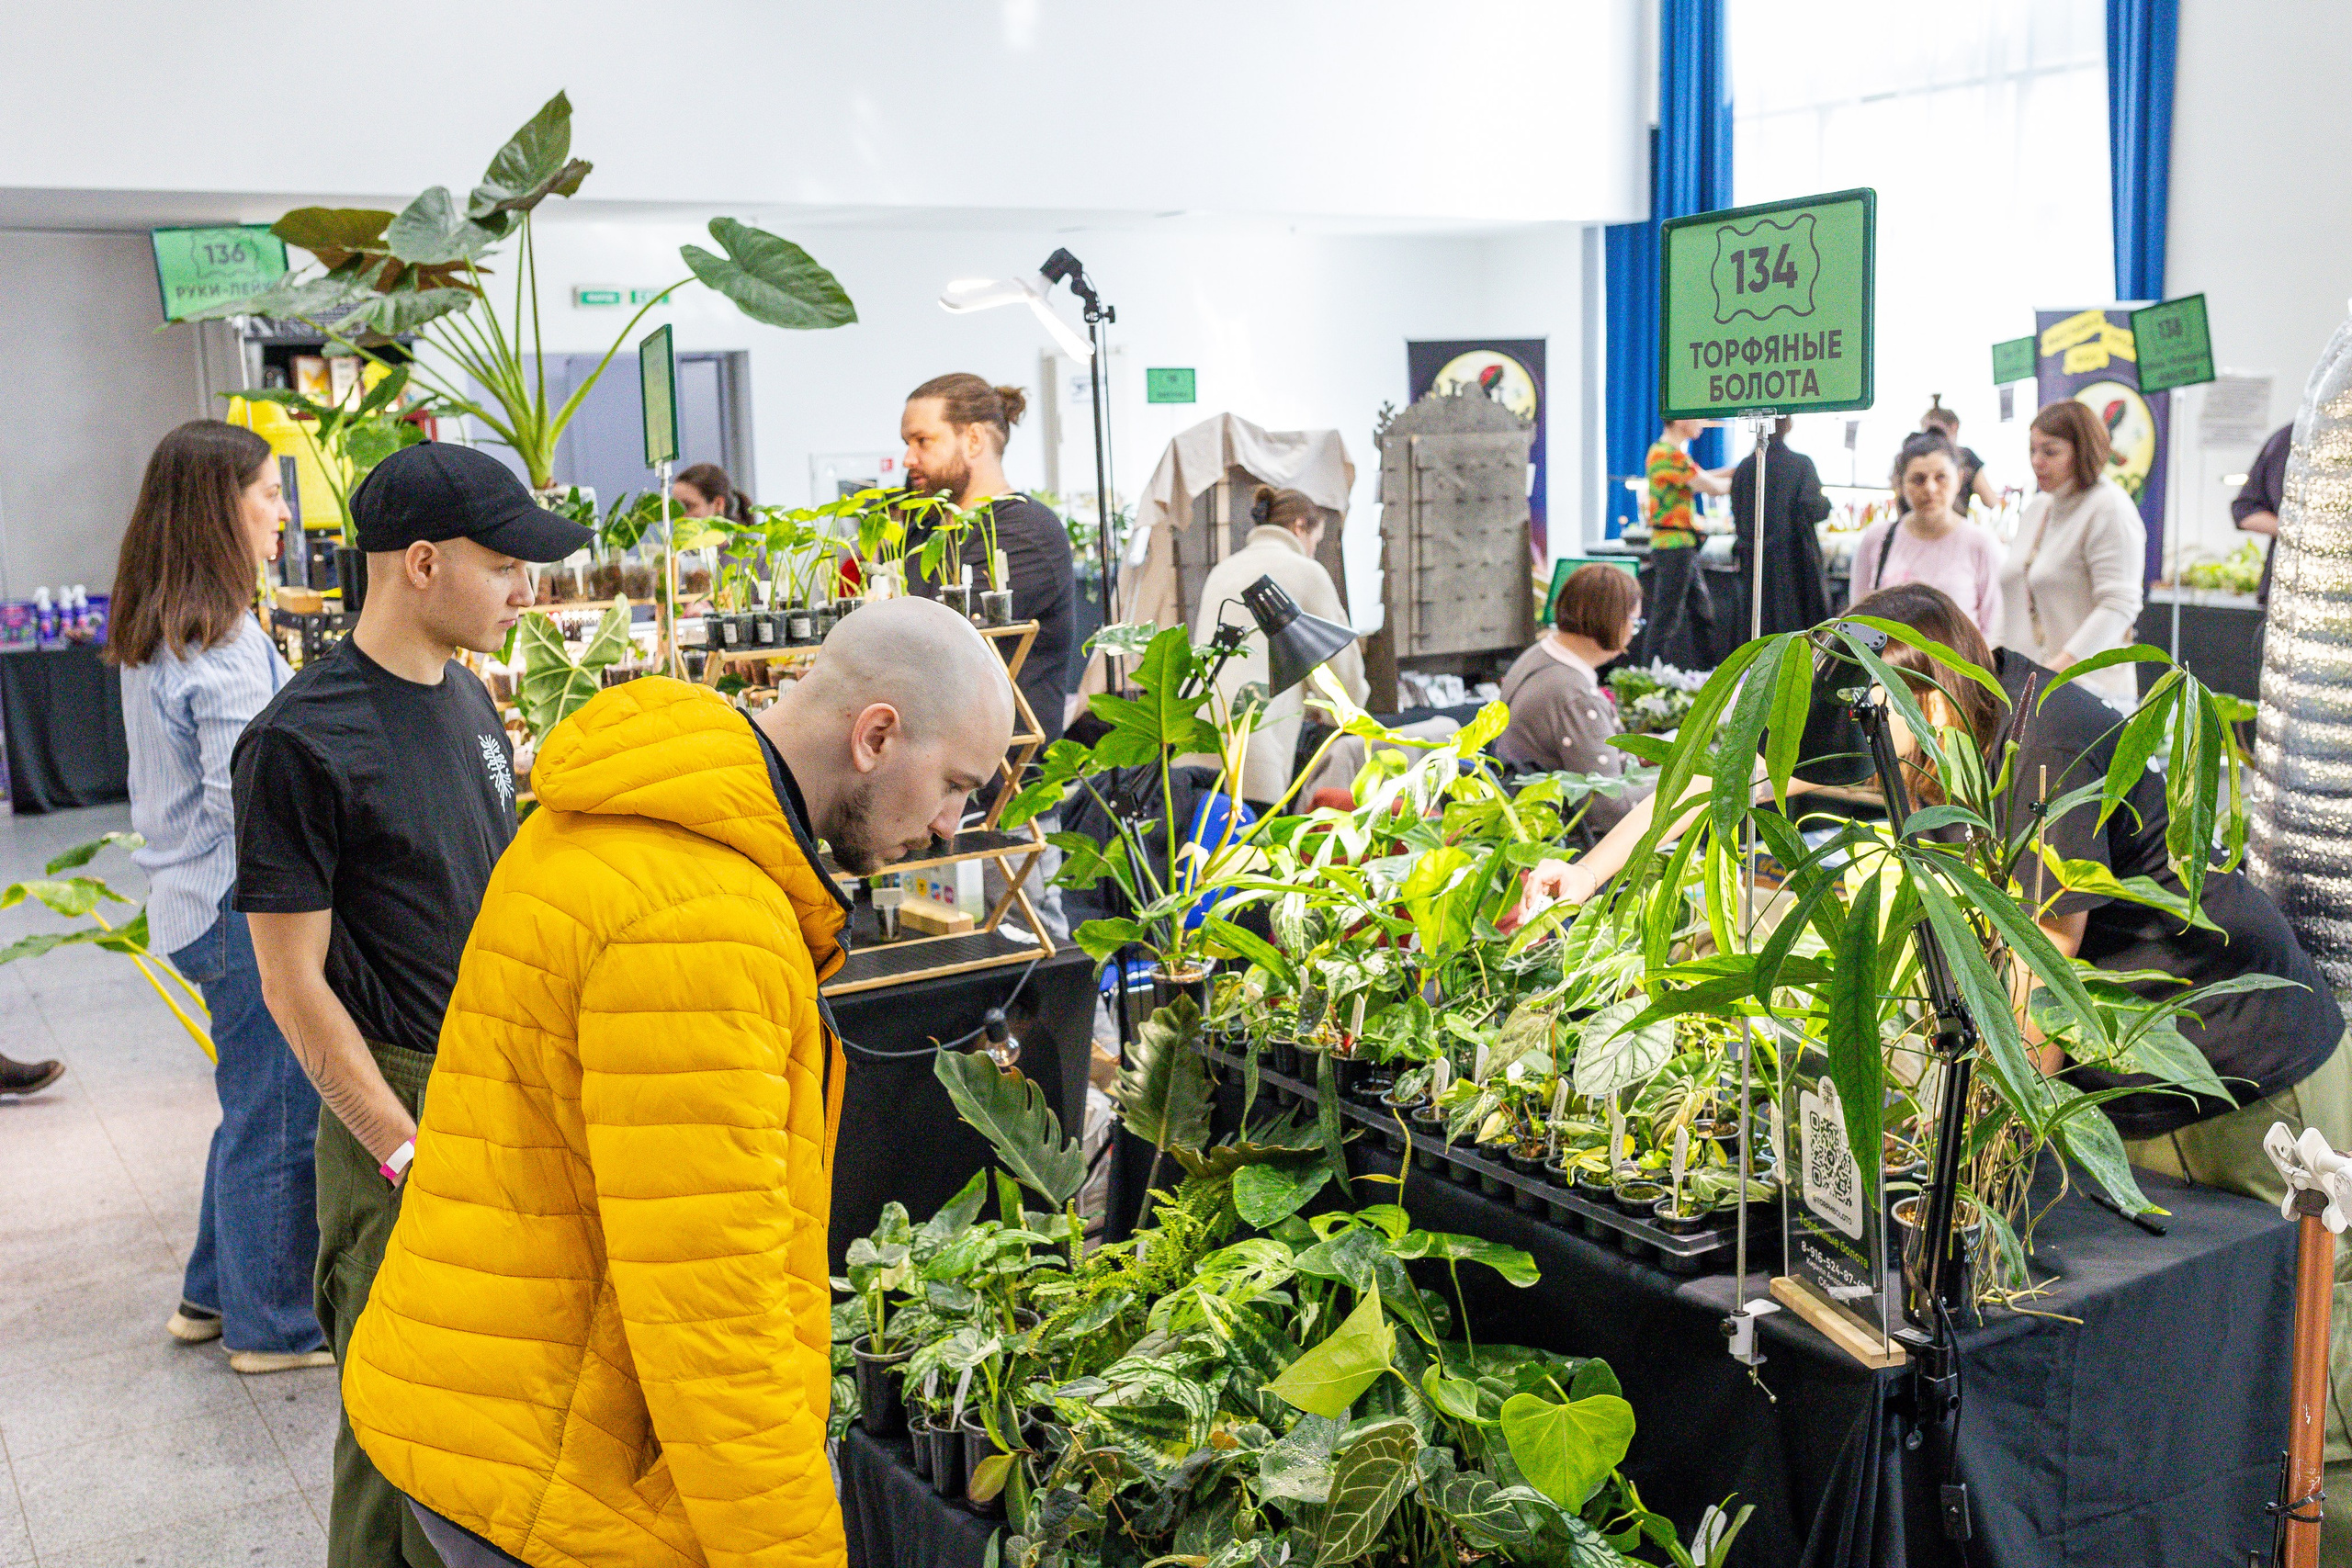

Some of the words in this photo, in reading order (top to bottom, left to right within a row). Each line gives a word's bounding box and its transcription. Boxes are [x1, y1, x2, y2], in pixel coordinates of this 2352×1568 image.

[203, 243, 246, 265] 136
[1729, 243, 1799, 295] 134
[1689, 329, 1843, 369] ТОРФЯНЫЕ
[1709, 368, 1821, 402] БОЛОТА
[1798, 1212, 1839, 1248] Торфяные
[1839, 1241, 1869, 1269] болота
